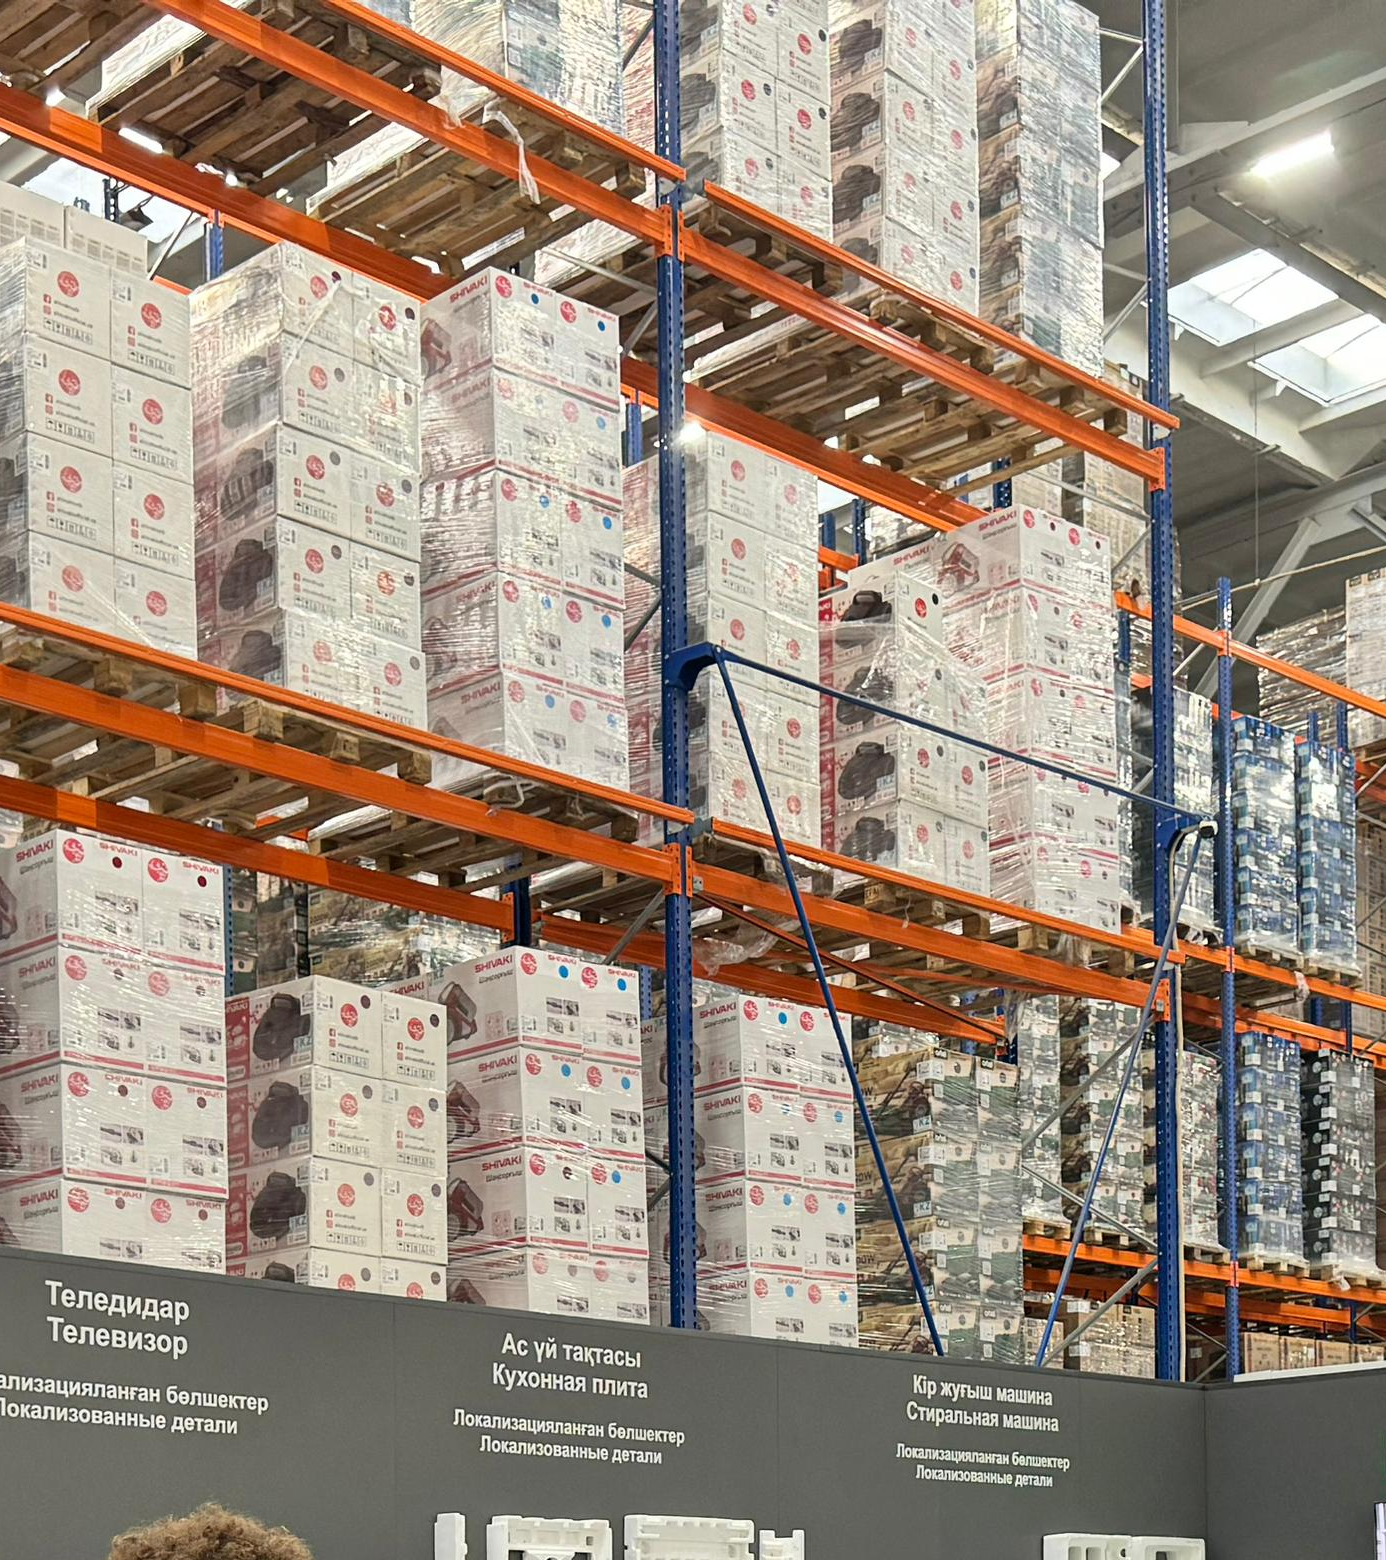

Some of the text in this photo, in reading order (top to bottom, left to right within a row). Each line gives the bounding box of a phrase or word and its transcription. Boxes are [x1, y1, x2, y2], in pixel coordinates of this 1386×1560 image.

[450, 275, 488, 303] SHIVAKI
[978, 511, 1017, 532] SHIVAKI
[461, 681, 501, 704] SHIVAKI
[16, 840, 53, 862] SHIVAKI
[99, 842, 138, 857] SHIVAKI
[182, 861, 219, 875] SHIVAKI
[19, 957, 56, 978] SHIVAKI
[475, 954, 512, 973] SHIVAKI
[699, 1002, 737, 1019] SHIVAKI
[300, 1036, 312, 1047] KZ
[478, 1055, 518, 1072] SHIVAKI
[20, 1074, 60, 1093] SHIVAKI
[704, 1094, 741, 1111] SHIVAKI
[298, 1124, 309, 1136] KZ
[481, 1156, 522, 1171] SHIVAKI
[19, 1190, 58, 1207] SHIVAKI
[104, 1188, 142, 1199] SHIVAKI
[705, 1187, 742, 1202] SHIVAKI
[295, 1215, 307, 1227] KZ
[45, 1280, 190, 1325] Теледидар
[46, 1316, 189, 1359] Телевизор
[501, 1333, 641, 1368] Ас үй тақтасы
[492, 1362, 648, 1399] Кухонная плита
[913, 1374, 1053, 1406] Кір жуғыш машина
[166, 1385, 269, 1413] бөлшектер
[170, 1413, 238, 1434] детали
[906, 1401, 1060, 1432] Стиральная машина
[453, 1408, 686, 1447] Локализацияланған бөлшектер
[480, 1435, 663, 1465] Локализованные детали
[896, 1443, 1070, 1472] Локализацияланған бөлшектер
[915, 1465, 1053, 1488] Локализованные детали
